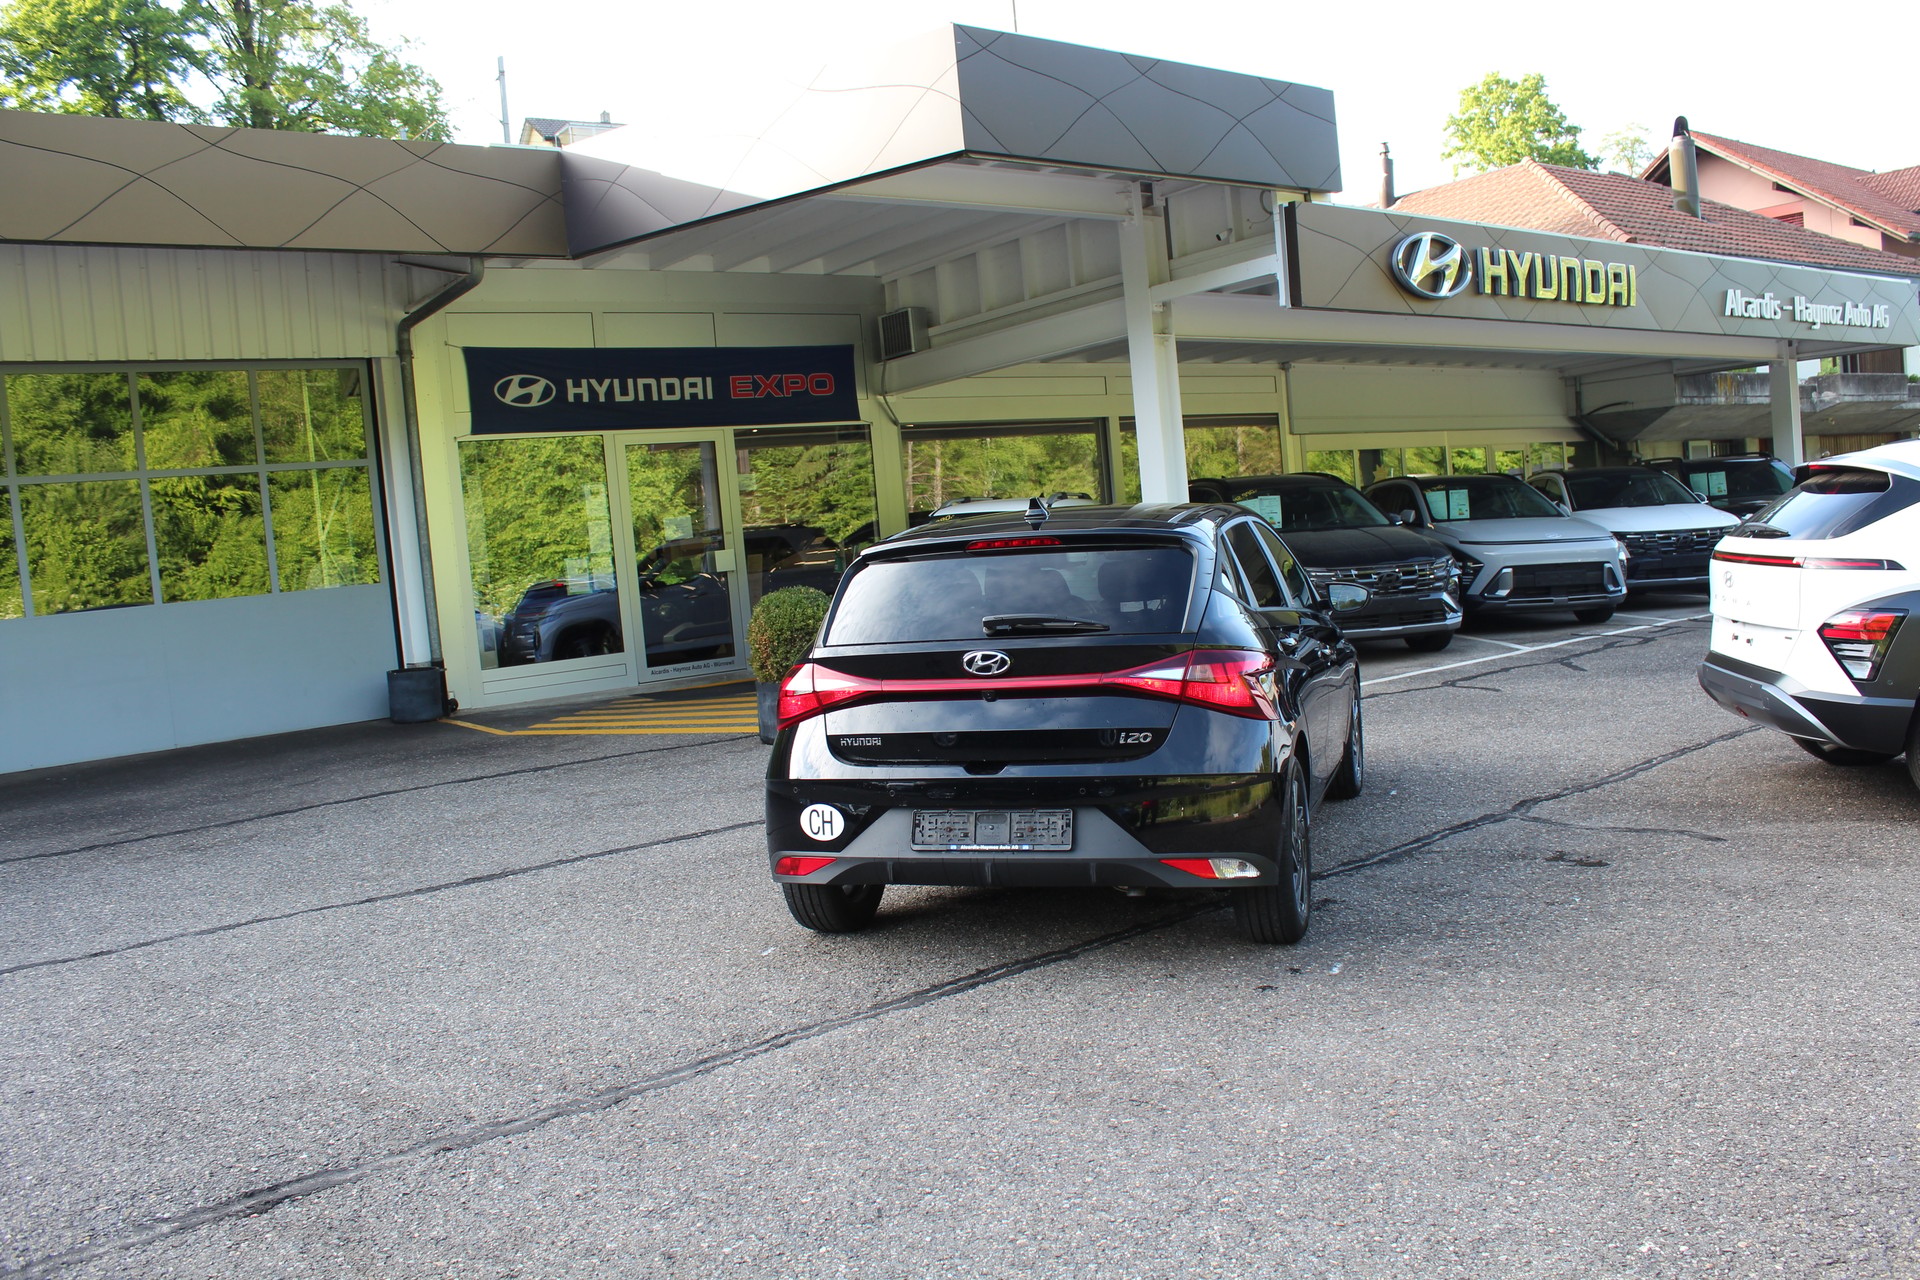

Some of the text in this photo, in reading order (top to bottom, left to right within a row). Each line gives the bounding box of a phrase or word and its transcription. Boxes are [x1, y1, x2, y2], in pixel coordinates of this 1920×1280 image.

[1477, 247, 1637, 307] HYUNDAI
[1725, 288, 1781, 320] Alcardis
[1794, 295, 1843, 330] Haymoz
[1844, 301, 1871, 328] Auto
[1872, 304, 1889, 328] AG
[566, 373, 835, 403] HYUNDAI EXPO
[840, 737, 882, 746] HYUNDAI
[809, 809, 834, 836] CH
